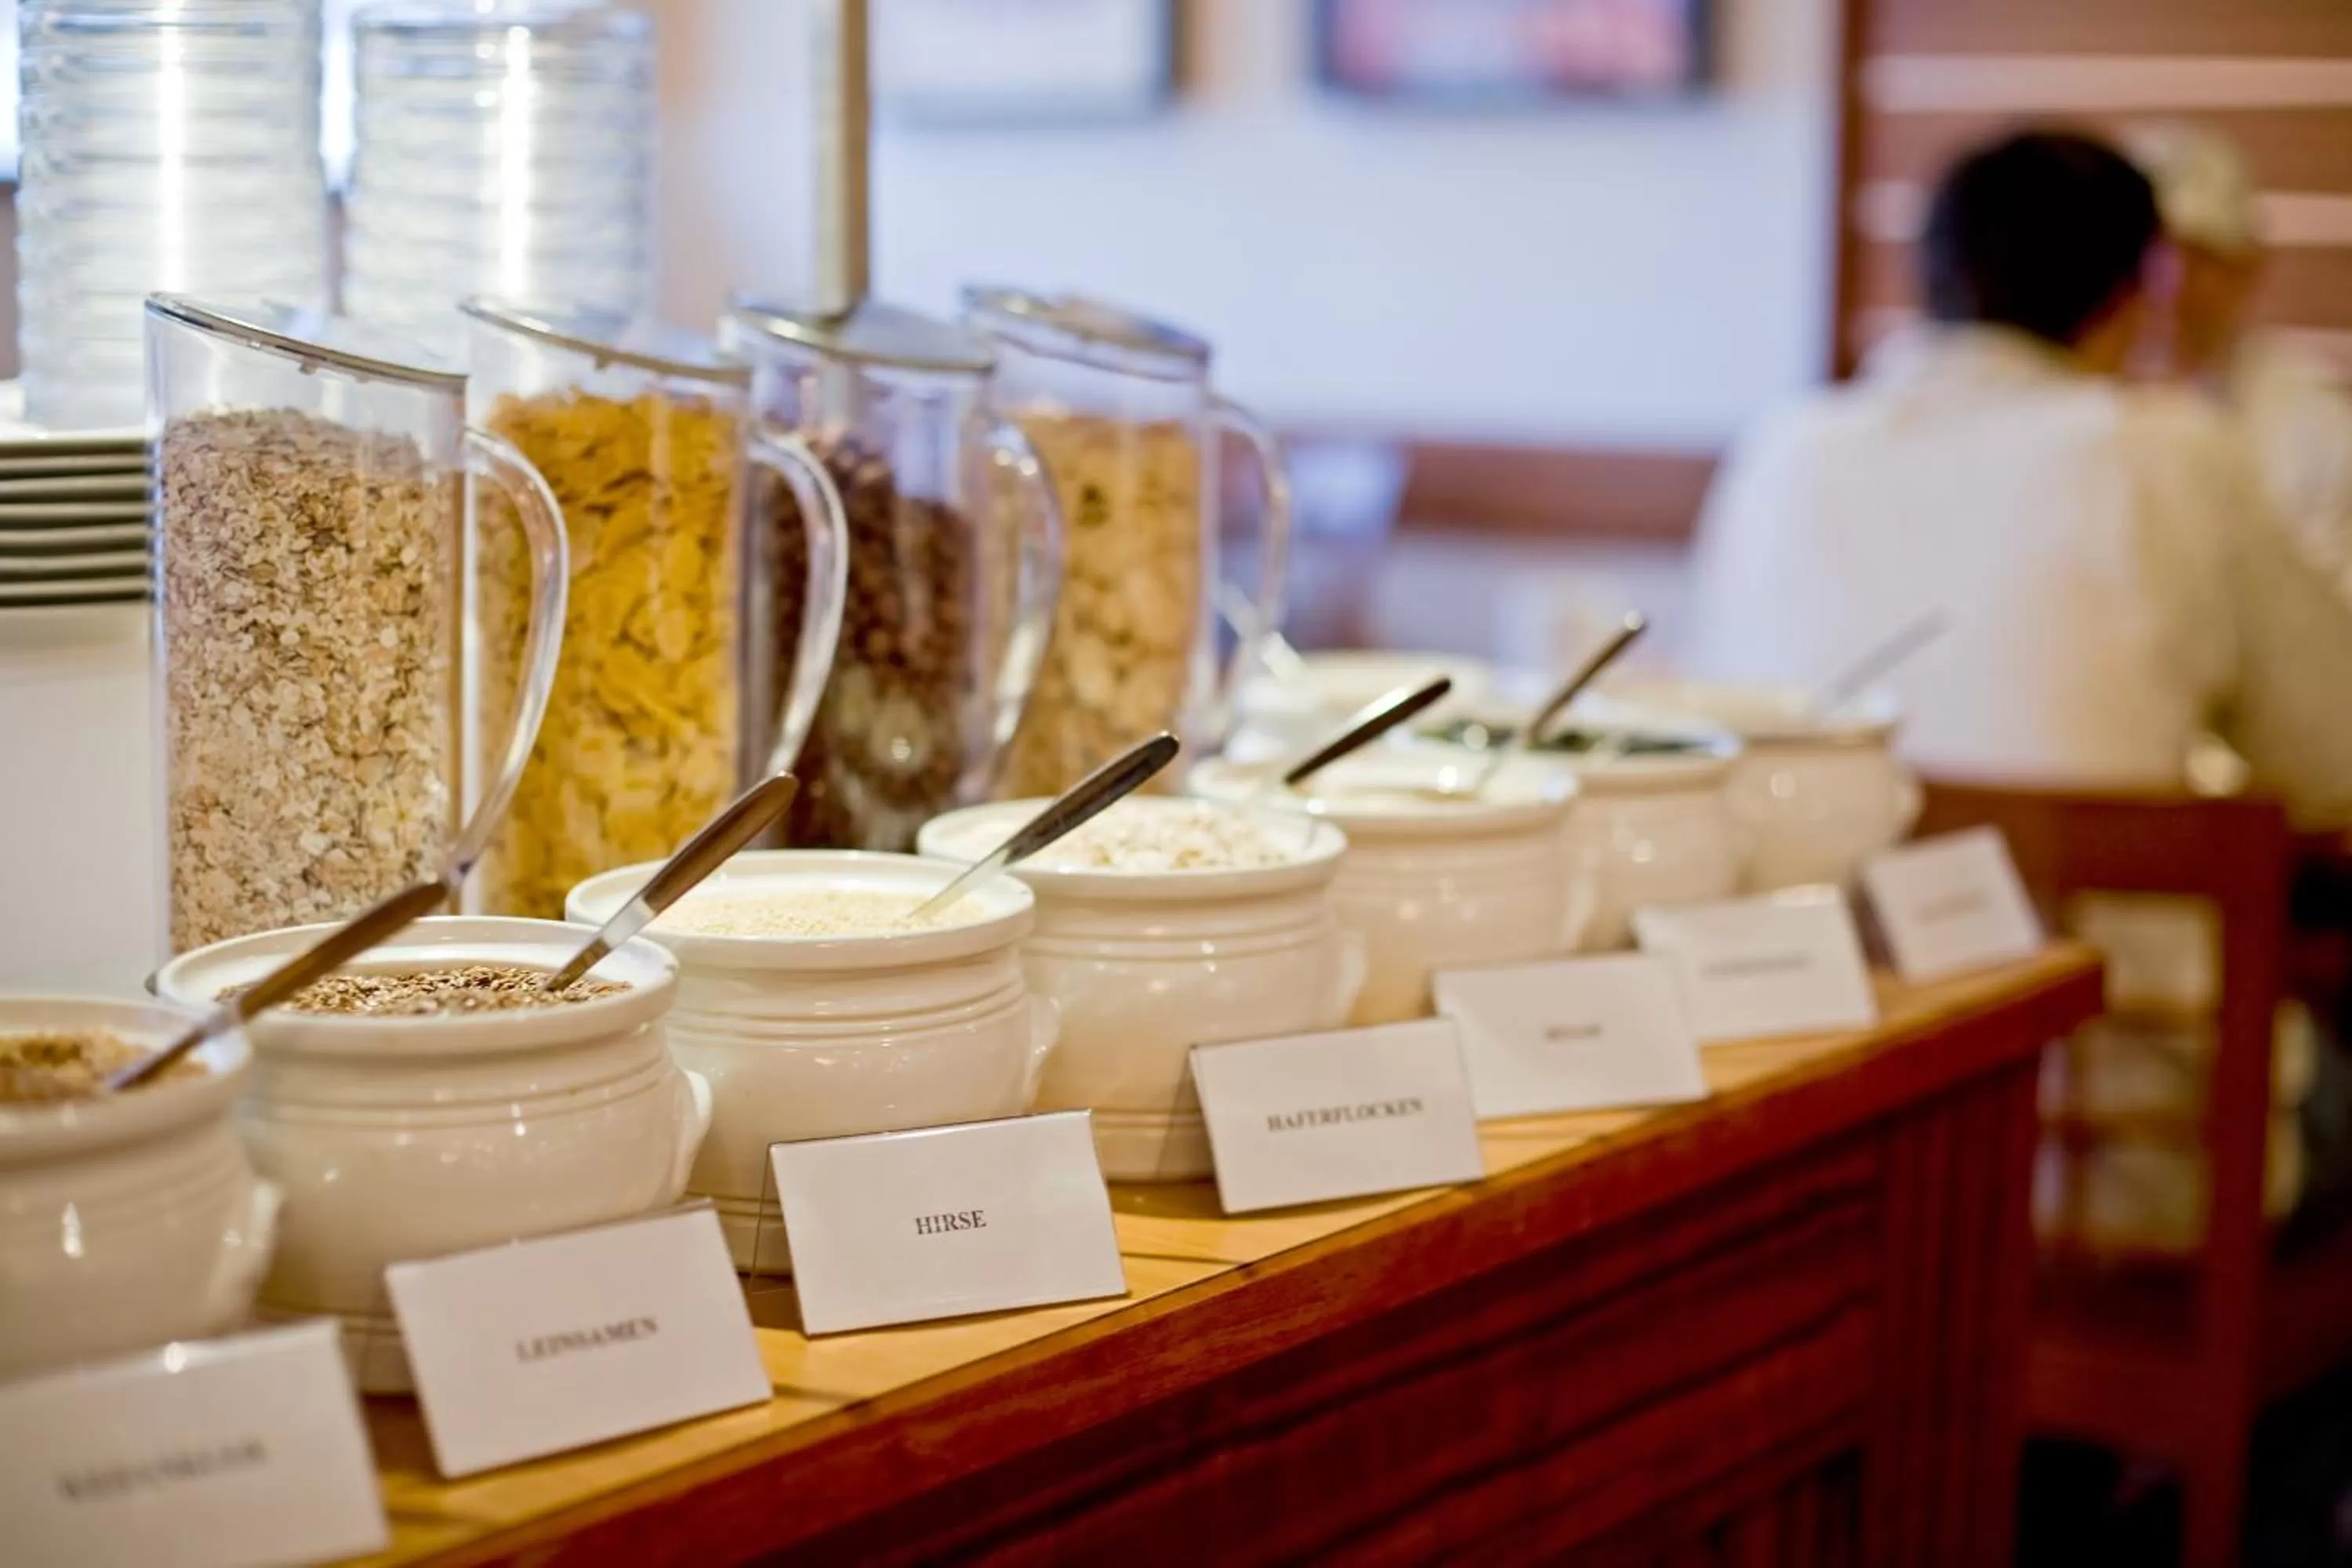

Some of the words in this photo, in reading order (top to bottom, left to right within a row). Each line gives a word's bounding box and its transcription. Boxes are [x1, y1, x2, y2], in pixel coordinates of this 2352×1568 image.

[1266, 1095, 1423, 1131] HAFERFLOCKEN
[915, 1209, 987, 1235] HIRSE
[514, 1316, 659, 1363] LEINSAMEN
